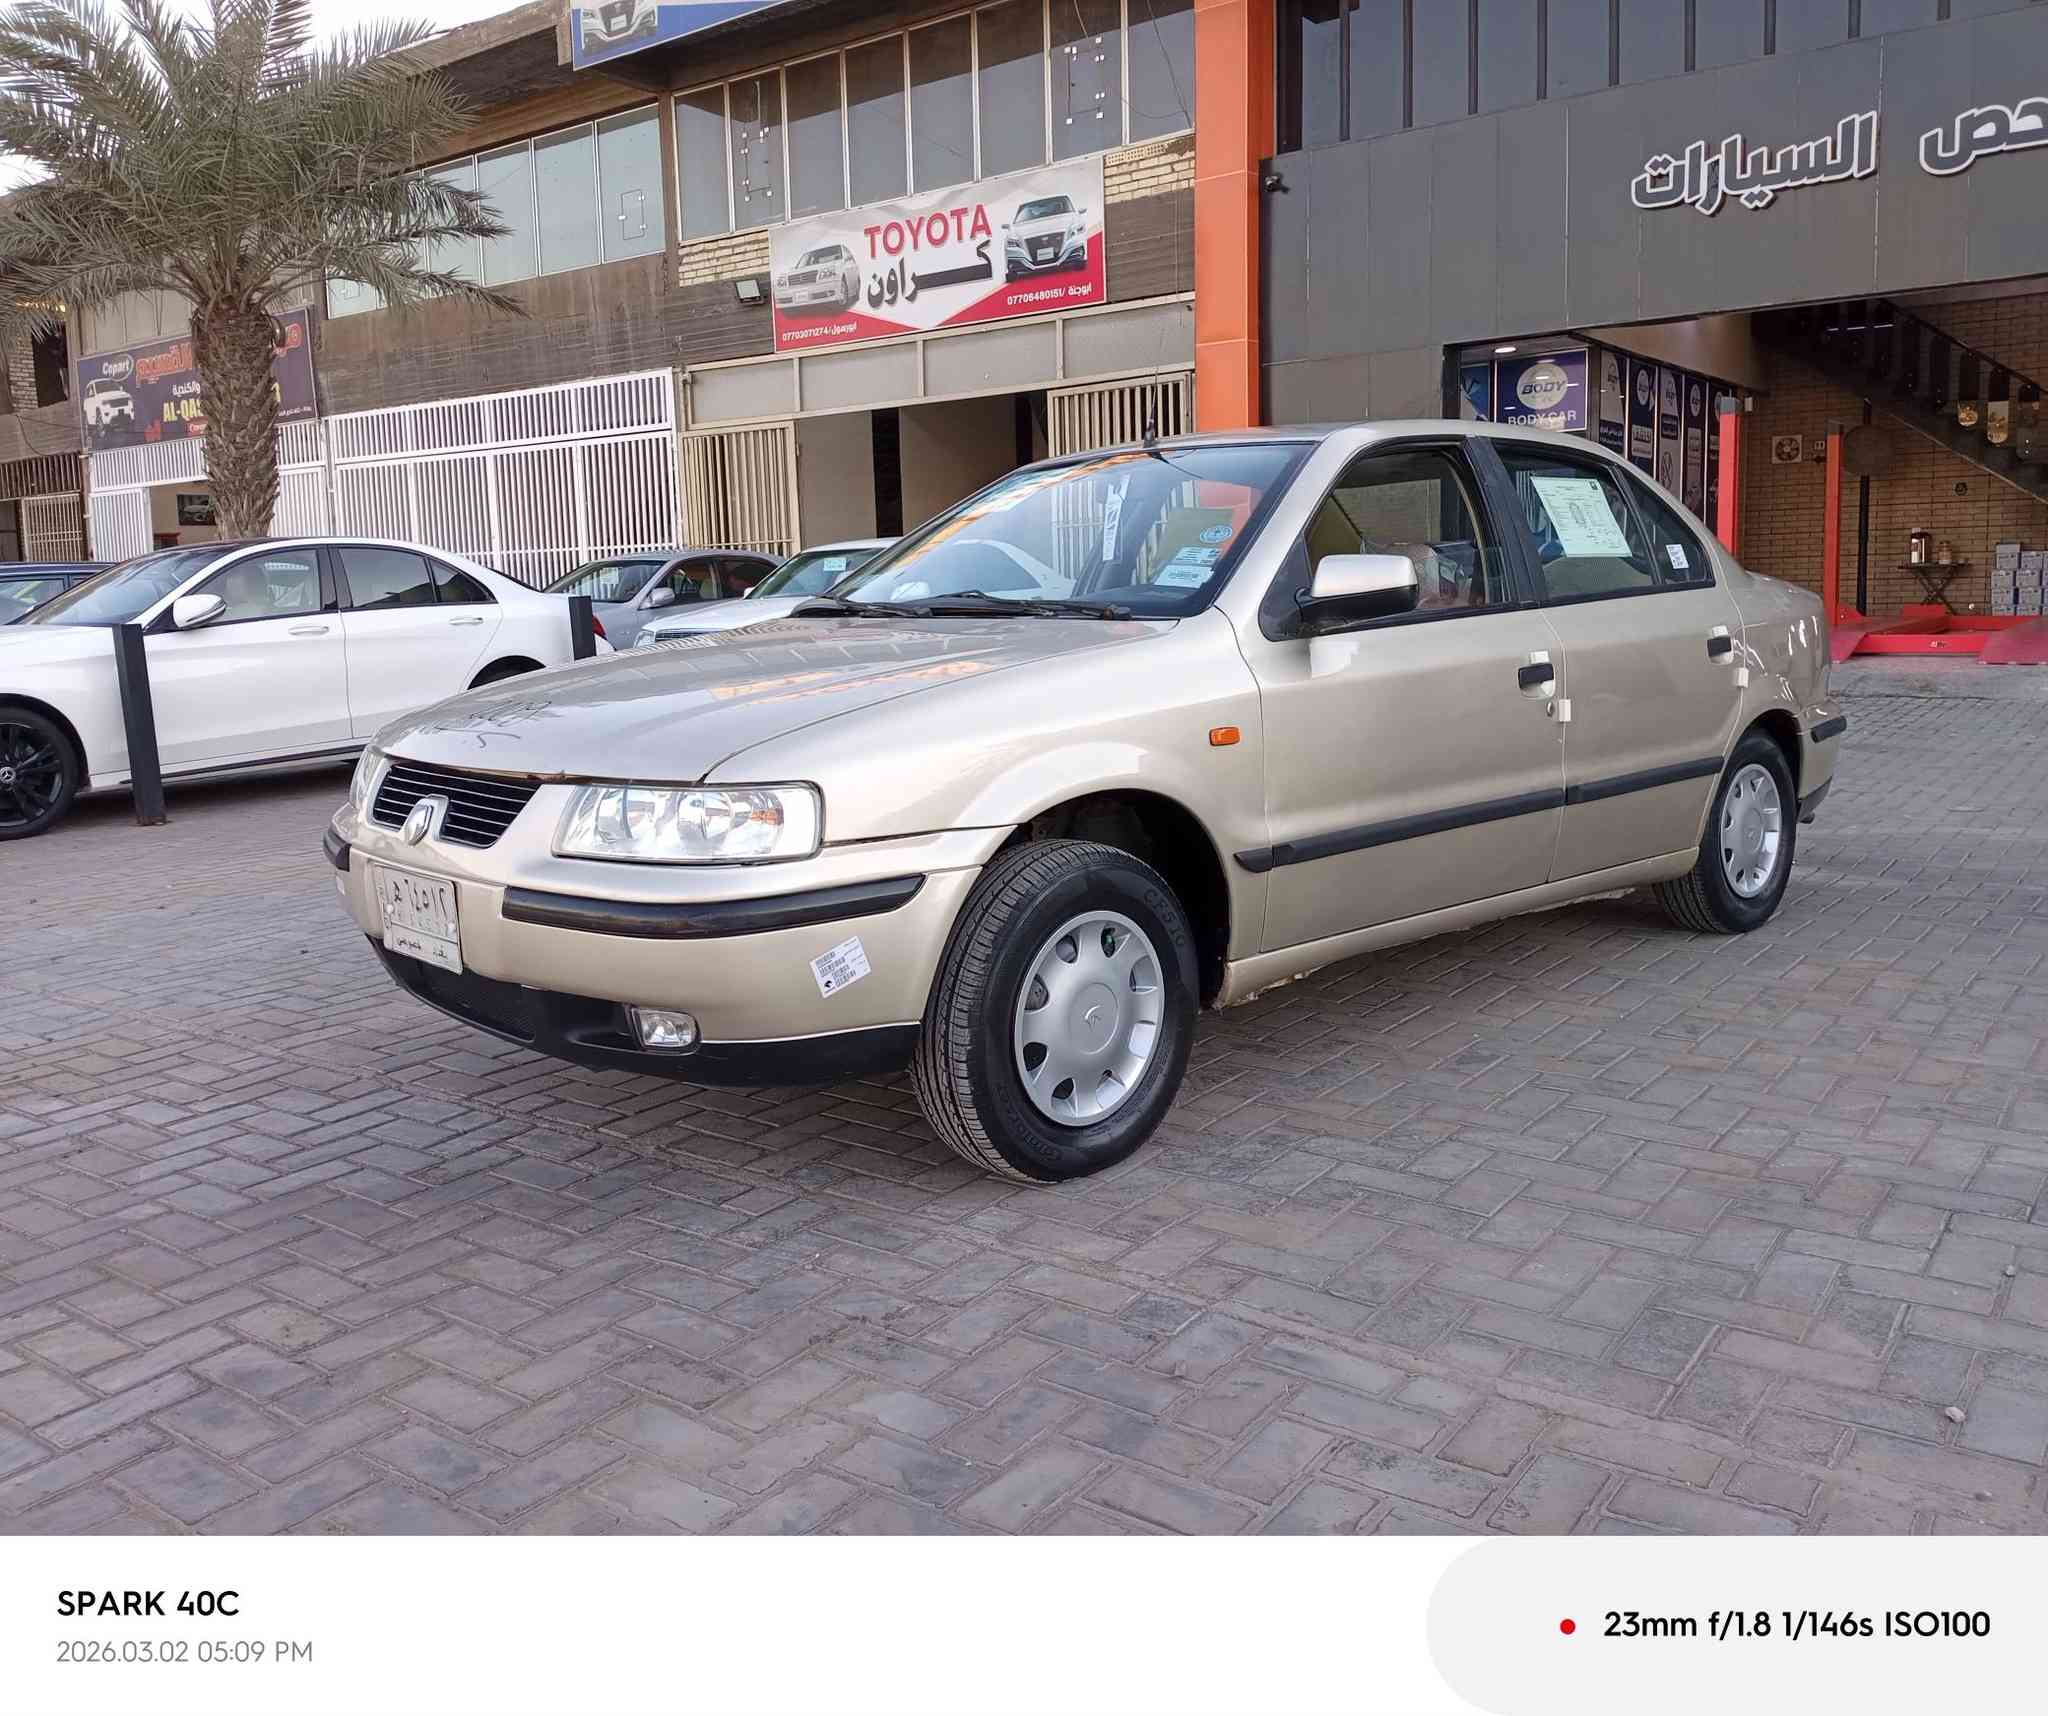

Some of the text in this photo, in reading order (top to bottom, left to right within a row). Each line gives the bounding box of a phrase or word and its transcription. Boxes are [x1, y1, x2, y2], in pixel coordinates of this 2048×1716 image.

[1630, 96, 2048, 216] حص السيارات
[863, 203, 992, 259] TOYOTA
[102, 359, 130, 377] Copart
[1521, 380, 1566, 395] BODY
[1508, 409, 1577, 426] BODY CAR
